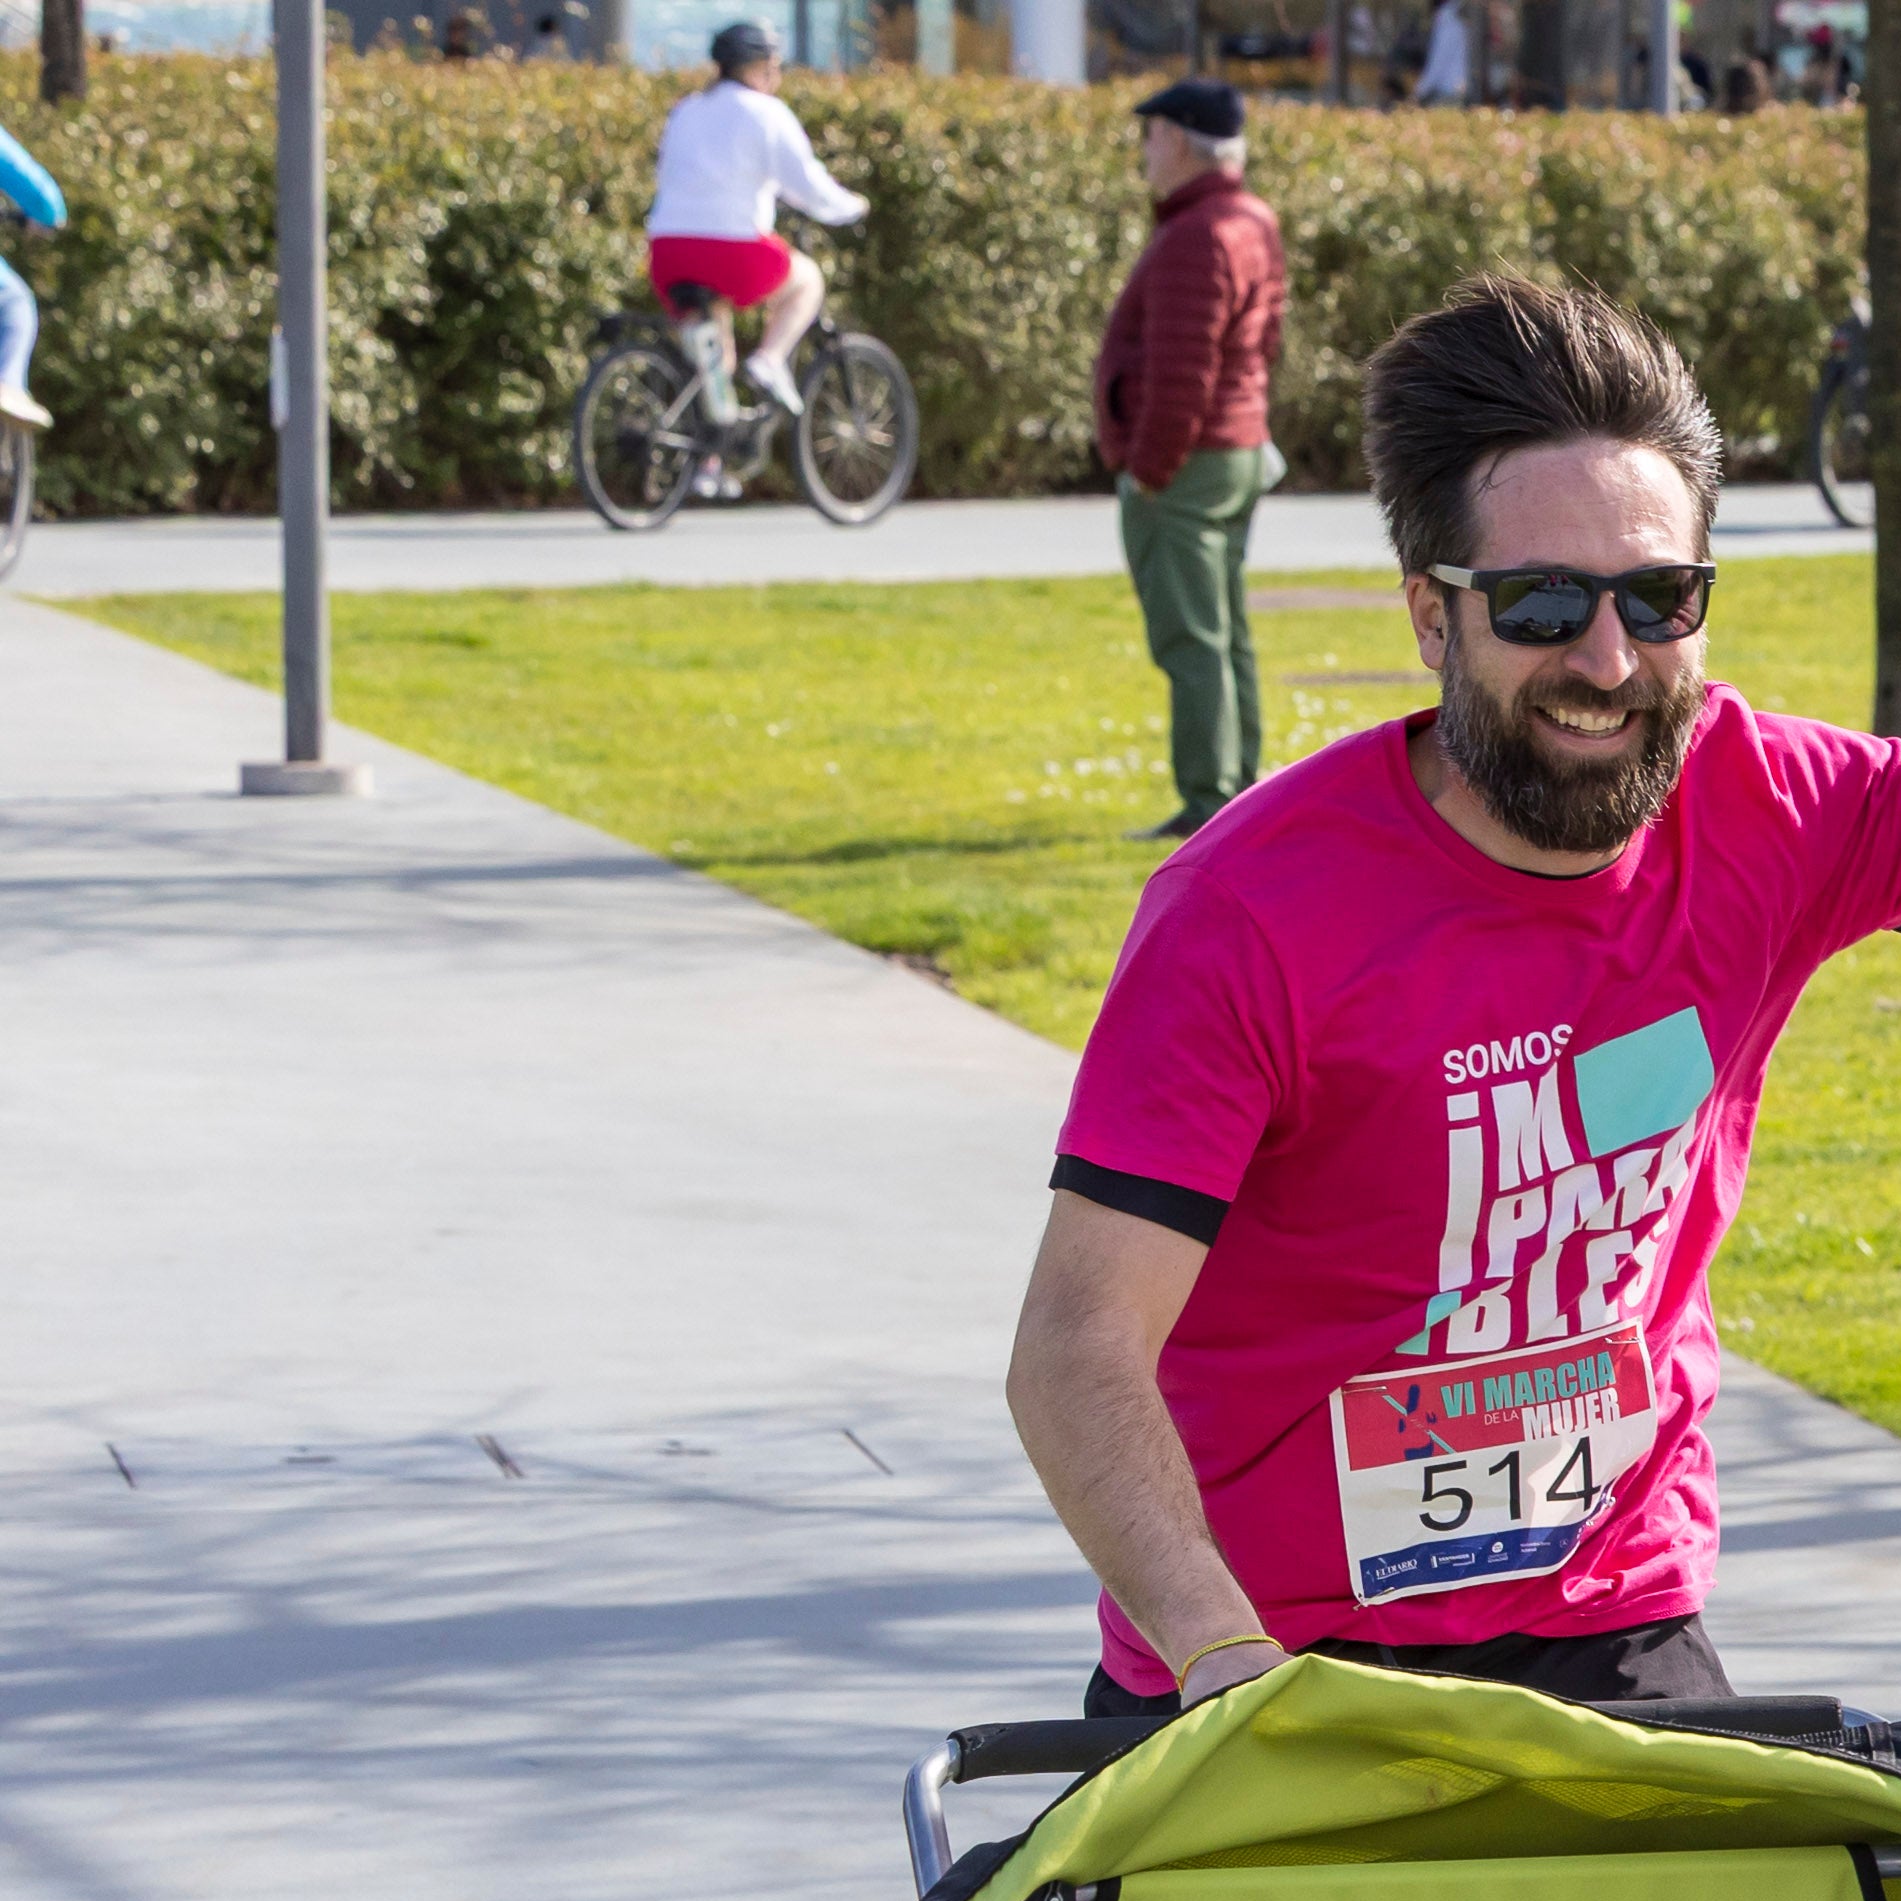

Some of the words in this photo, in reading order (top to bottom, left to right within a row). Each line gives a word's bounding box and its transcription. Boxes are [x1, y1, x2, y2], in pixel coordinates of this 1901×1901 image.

[1443, 1024, 1573, 1084] SOMOS
[1486, 1112, 1698, 1278] PARA
[1440, 1380, 1476, 1418] VI
[1483, 1351, 1616, 1411] MARCHA
[1484, 1412, 1500, 1426] DE
[1503, 1411, 1519, 1423] LA
[1521, 1387, 1622, 1442] MUJER
[1419, 1436, 1601, 1532] 514
